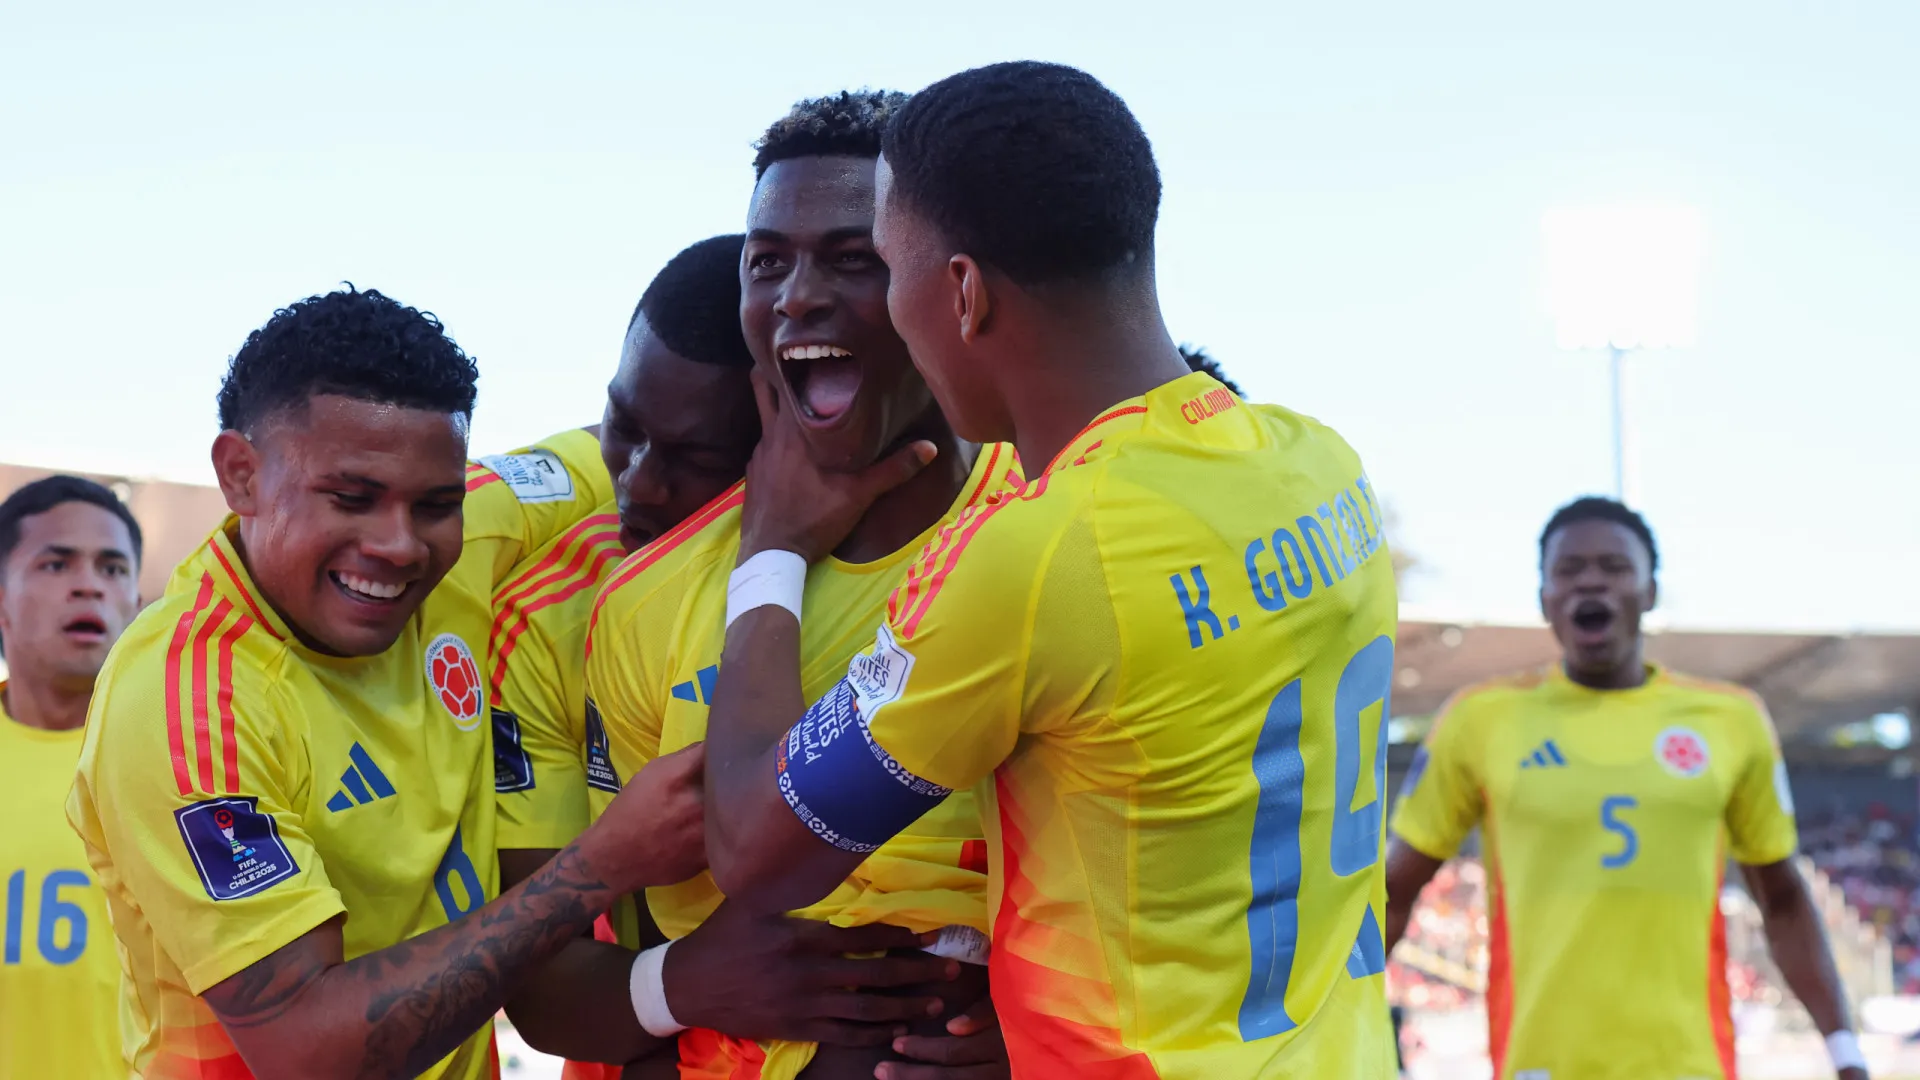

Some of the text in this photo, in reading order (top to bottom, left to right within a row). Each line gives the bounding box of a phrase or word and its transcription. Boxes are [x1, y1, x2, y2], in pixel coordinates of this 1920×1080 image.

[1169, 564, 1240, 649] K.
[802, 715, 822, 764] World
[818, 682, 842, 747] UNITES
[238, 858, 257, 870] FIFA
[1237, 635, 1394, 1042] 19
[1600, 795, 1638, 869] 5
[229, 863, 277, 890] CHILE 2025
[5, 869, 91, 965] 16
